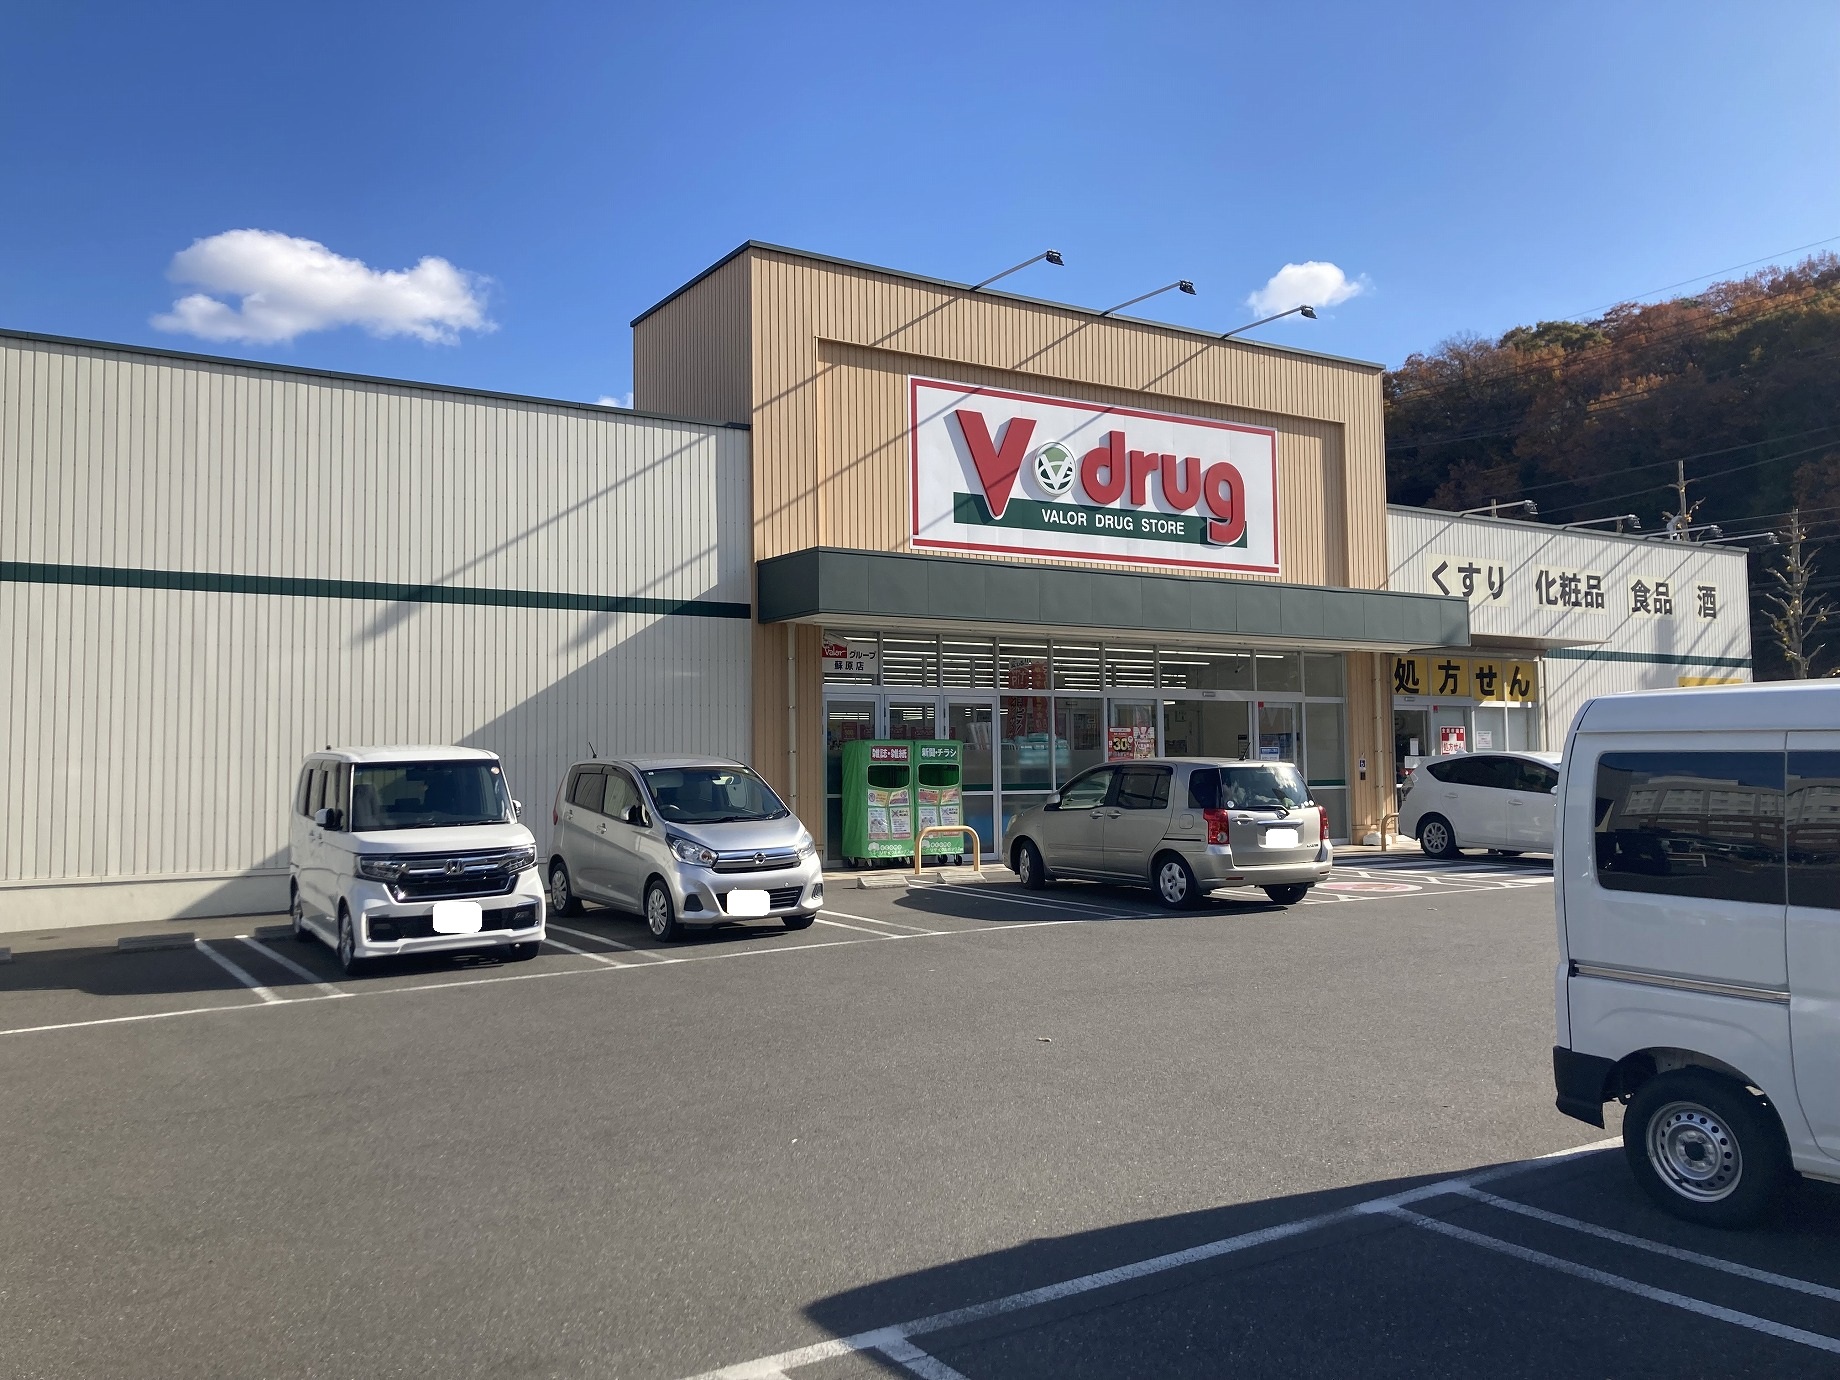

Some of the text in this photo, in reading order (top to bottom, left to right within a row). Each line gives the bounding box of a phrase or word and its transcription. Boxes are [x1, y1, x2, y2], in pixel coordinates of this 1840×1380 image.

[1042, 508, 1186, 535] VALOR DRUG STORE
[1431, 560, 1717, 619] くすり 化粧品 食品 酒
[849, 650, 876, 660] グループ
[1394, 657, 1530, 697] 処方せん
